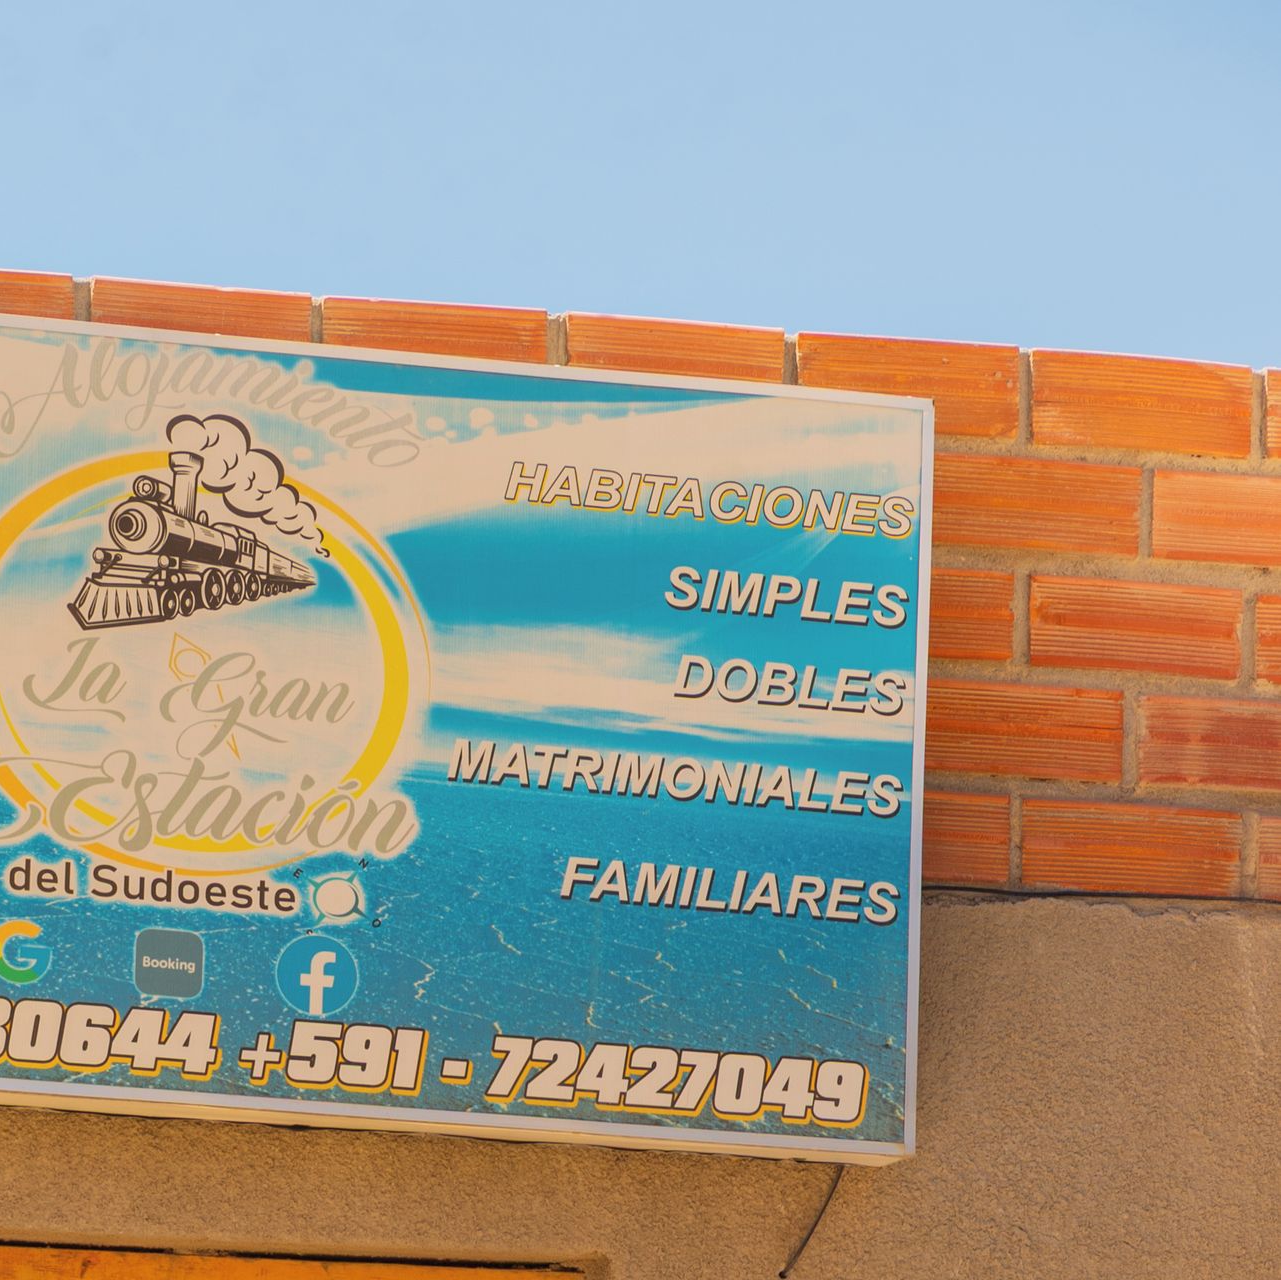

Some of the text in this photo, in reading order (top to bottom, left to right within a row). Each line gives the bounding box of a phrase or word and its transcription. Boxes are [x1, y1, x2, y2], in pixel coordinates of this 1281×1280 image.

[504, 461, 915, 538] HABITACIONES
[664, 566, 910, 628] SIMPLES
[23, 636, 356, 760] La Gran
[673, 655, 909, 717] DOBLES
[447, 738, 904, 819] MATRIMONIALES
[8, 858, 297, 913] del Sudoeste
[560, 856, 900, 925] FAMILIARES
[142, 955, 196, 974] Booking
[238, 1019, 429, 1096] +591
[484, 1034, 870, 1130] 72427049
